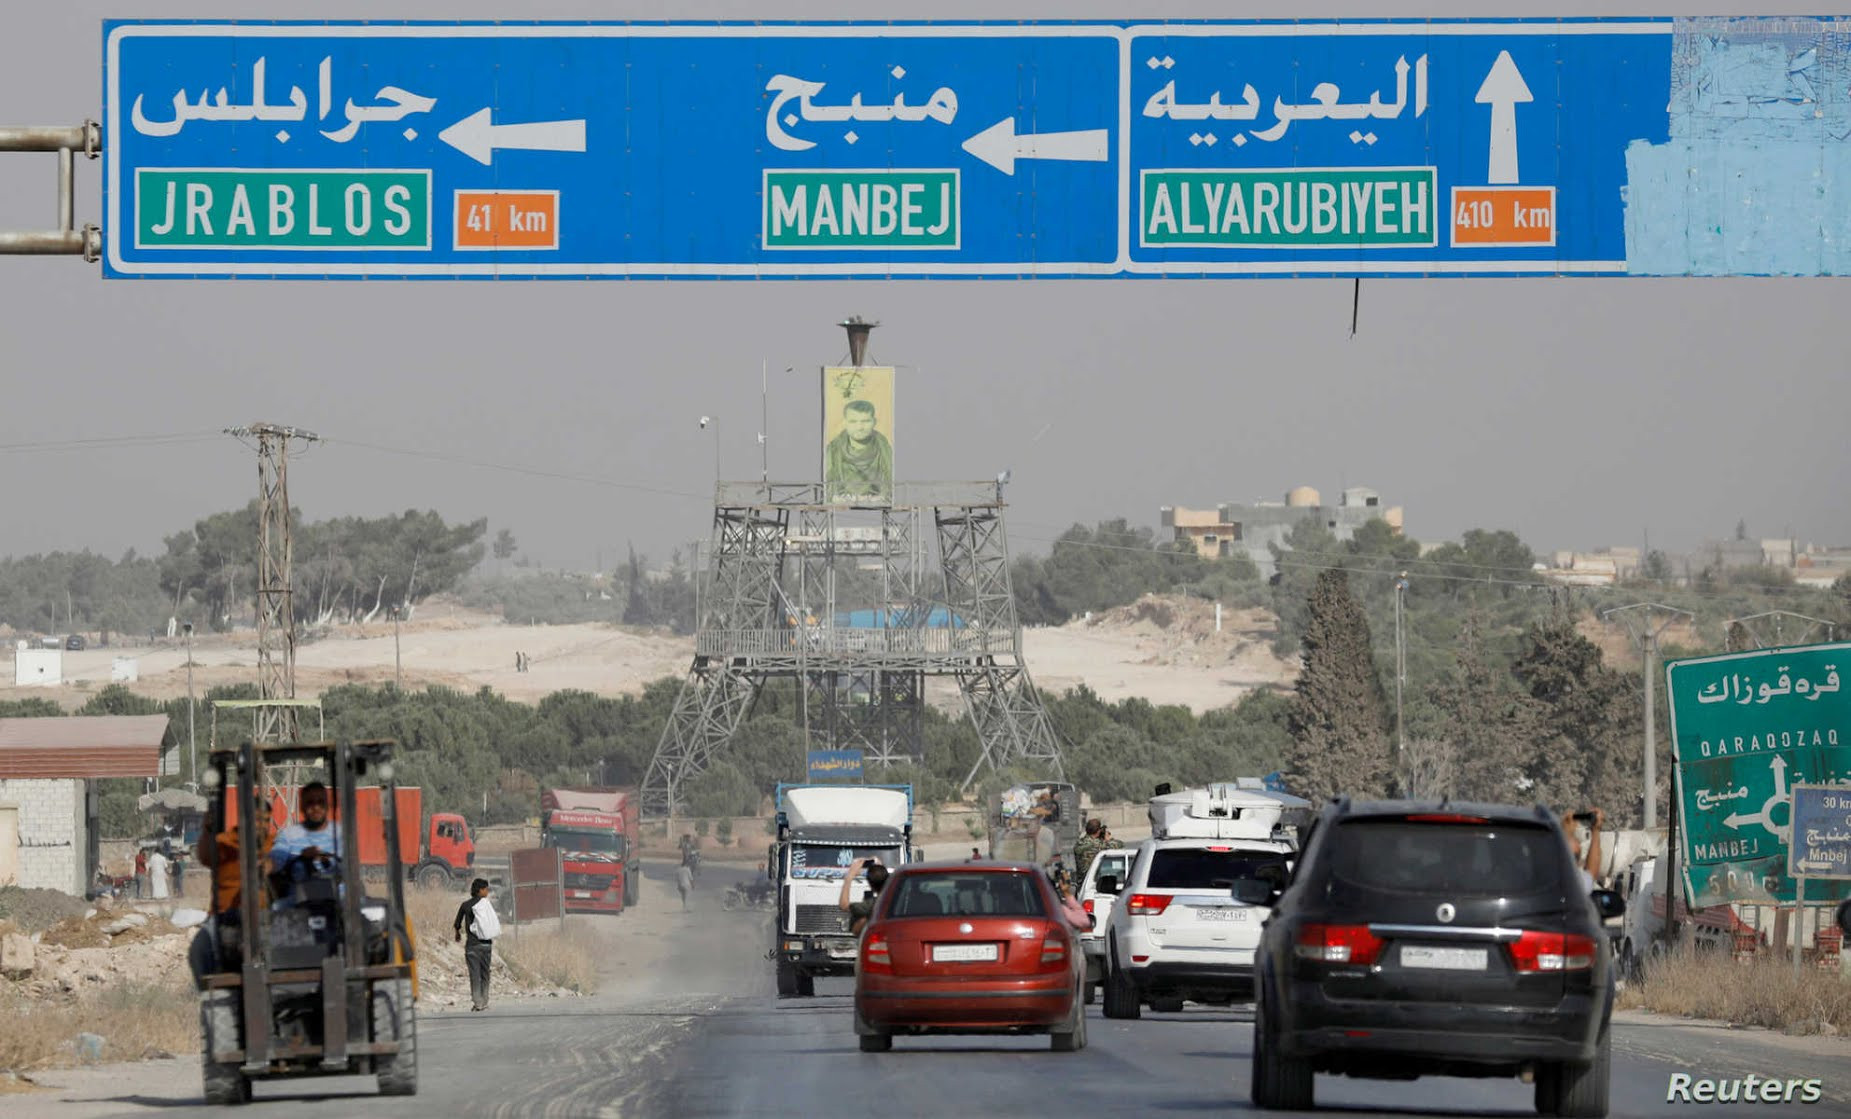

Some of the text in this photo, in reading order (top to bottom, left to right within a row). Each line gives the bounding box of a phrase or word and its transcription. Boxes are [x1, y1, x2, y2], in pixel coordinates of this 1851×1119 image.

[132, 56, 437, 143] جرابلس
[765, 65, 958, 151] منبج
[1142, 53, 1428, 147] اليعربية
[151, 181, 411, 236] JRABLOS
[466, 204, 547, 232] 41 km
[771, 182, 950, 236] MANBEJ
[1148, 181, 1427, 234] ALYARUBIYEH
[1456, 200, 1550, 229] 410 km
[1697, 666, 1792, 705] قوزاك
[1701, 729, 1838, 757] QARAQOZAQ
[1695, 782, 1749, 810] منبج
[1823, 797, 1836, 809] 30
[1694, 838, 1759, 861] MANBEJ
[1808, 848, 1849, 865] Mnbej
